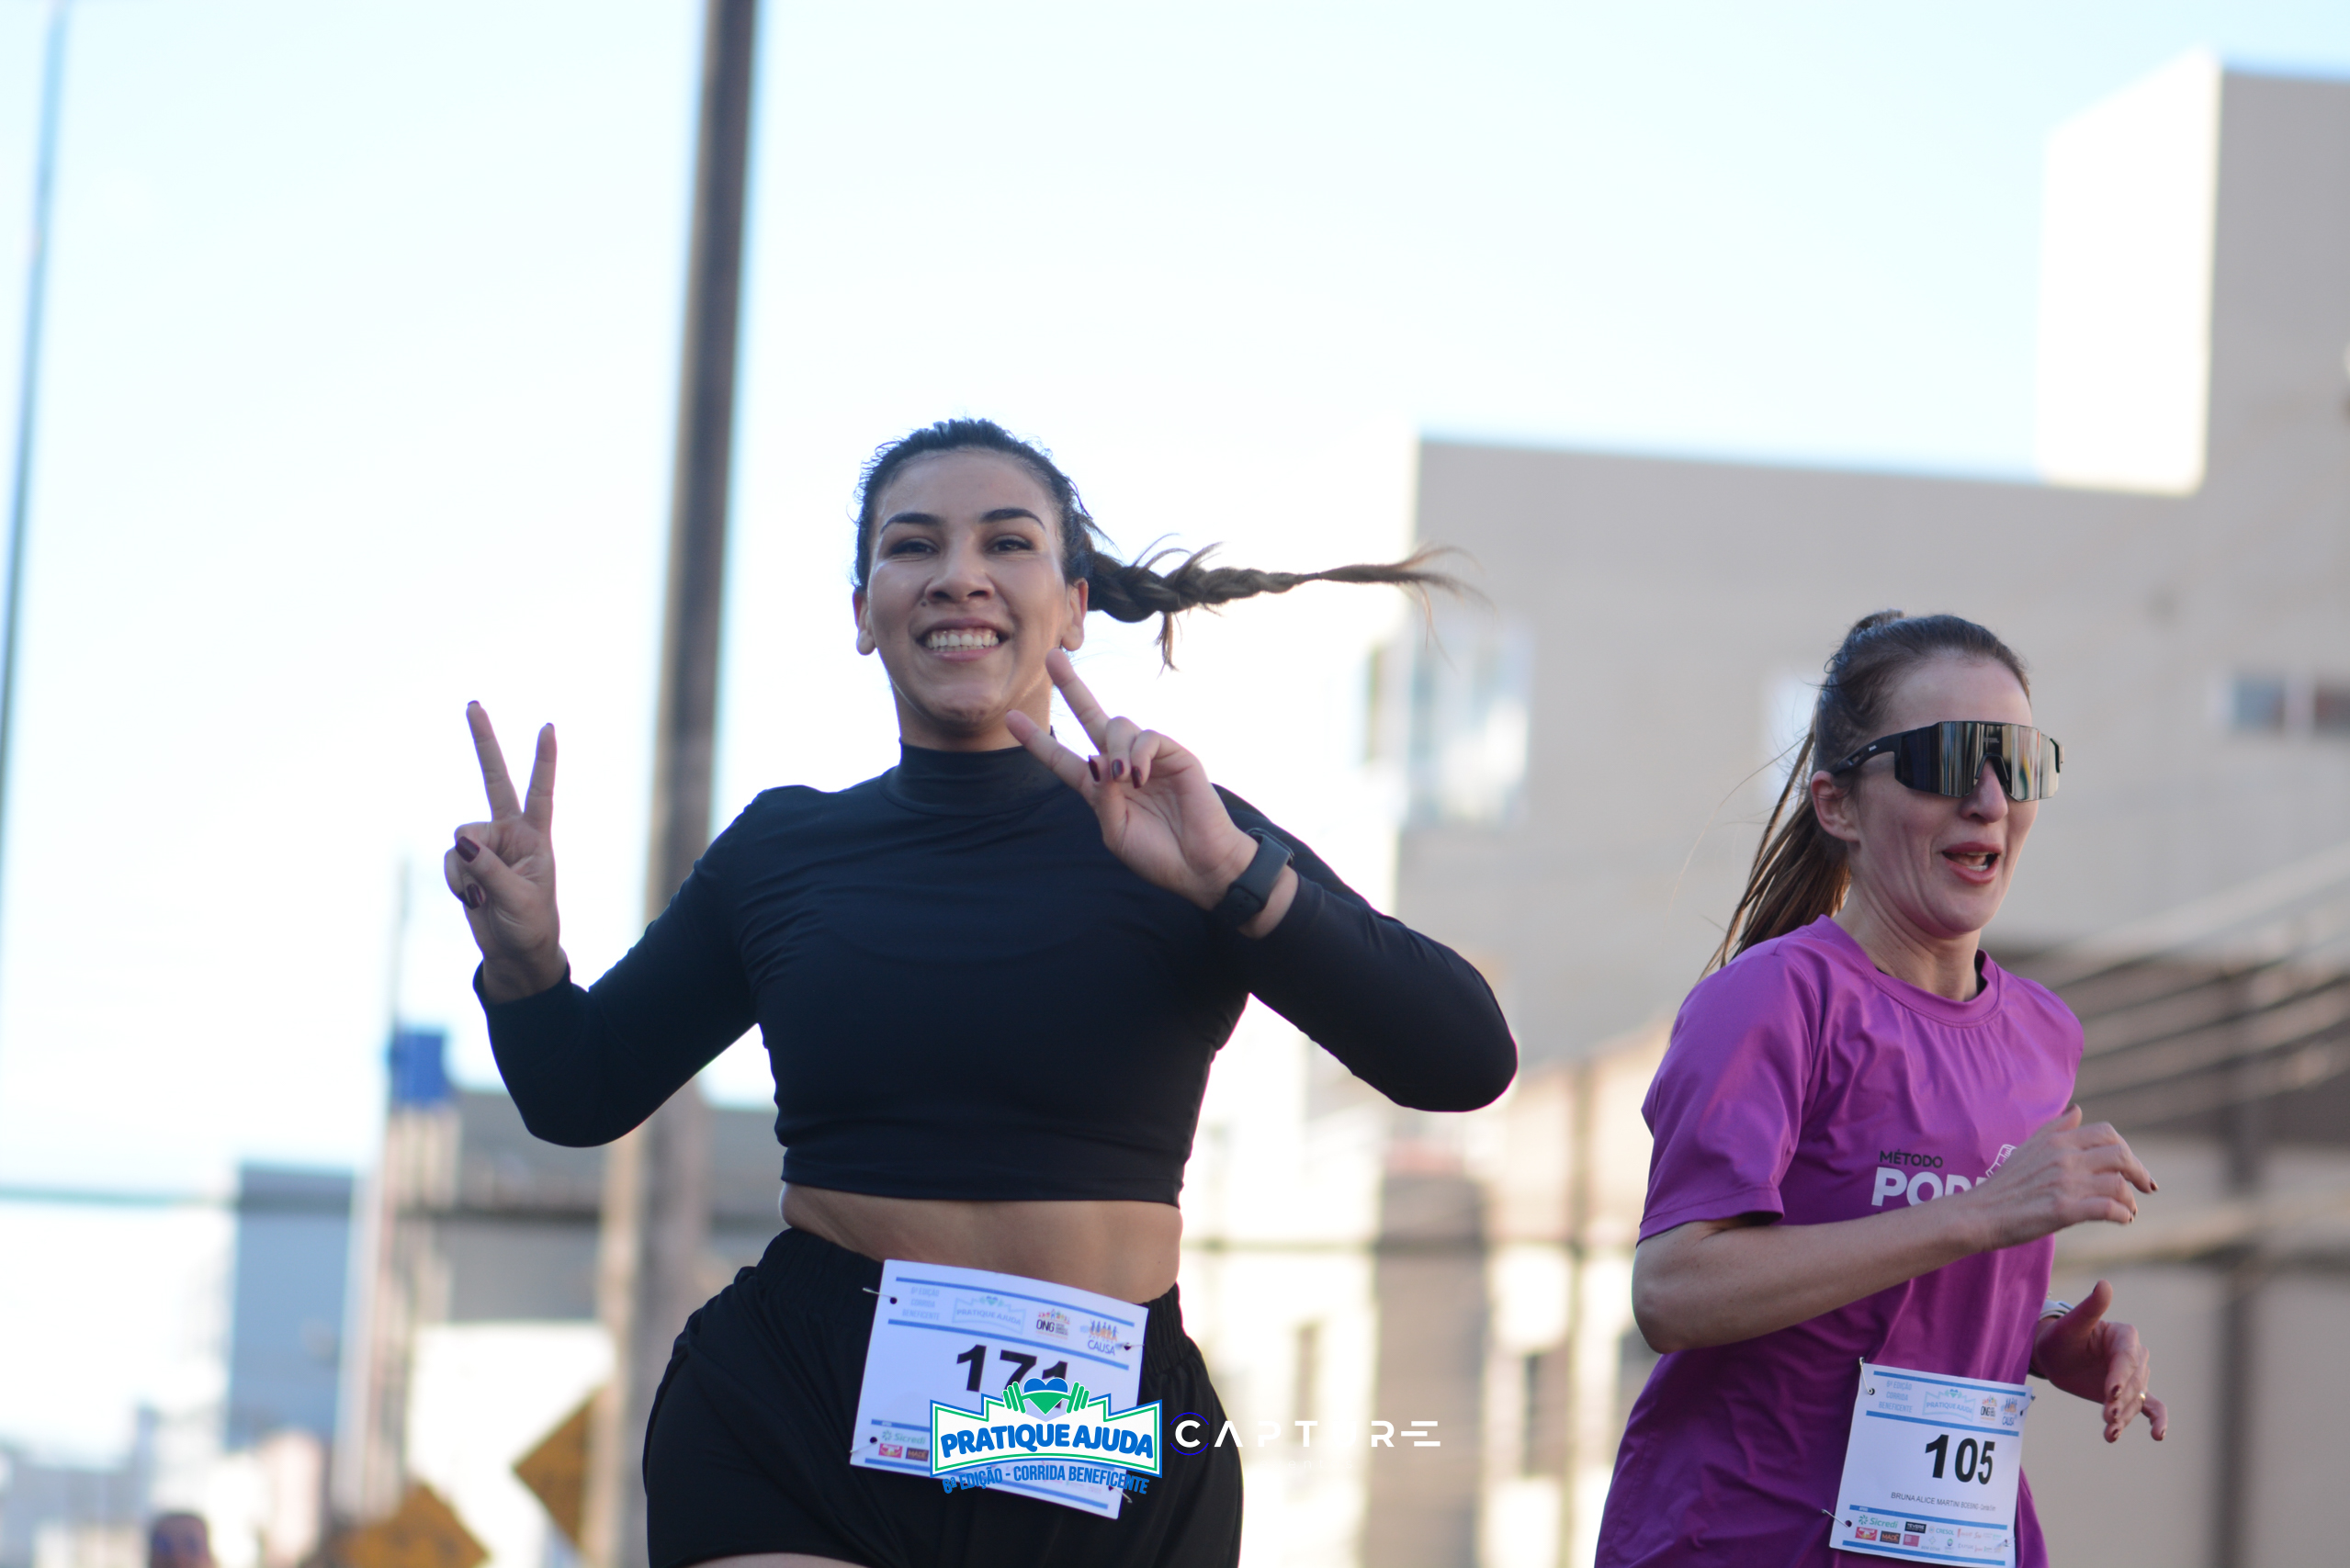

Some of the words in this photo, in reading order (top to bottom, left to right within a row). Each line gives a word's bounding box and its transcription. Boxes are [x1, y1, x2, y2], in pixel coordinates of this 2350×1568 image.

[1879, 1149, 1943, 1168] MÉTODO
[1871, 1167, 1989, 1207] POD
[910, 1298, 935, 1309] CORRIDA
[902, 1308, 940, 1321] BENEFICENTE
[956, 1308, 995, 1320] PRATIQUE
[996, 1314, 1022, 1325] AJUDA
[1035, 1319, 1056, 1333] ONG
[1088, 1339, 1115, 1356] CAUSA
[1926, 1402, 1957, 1410] PRATIQUE
[894, 1432, 926, 1445] Sicredi
[1925, 1434, 1995, 1485] 105
[1891, 1492, 1915, 1502] BRUNA
[1915, 1495, 1936, 1505] ALICE
[1937, 1498, 1960, 1507] MARTINI
[1869, 1517, 1899, 1529] Sicredi
